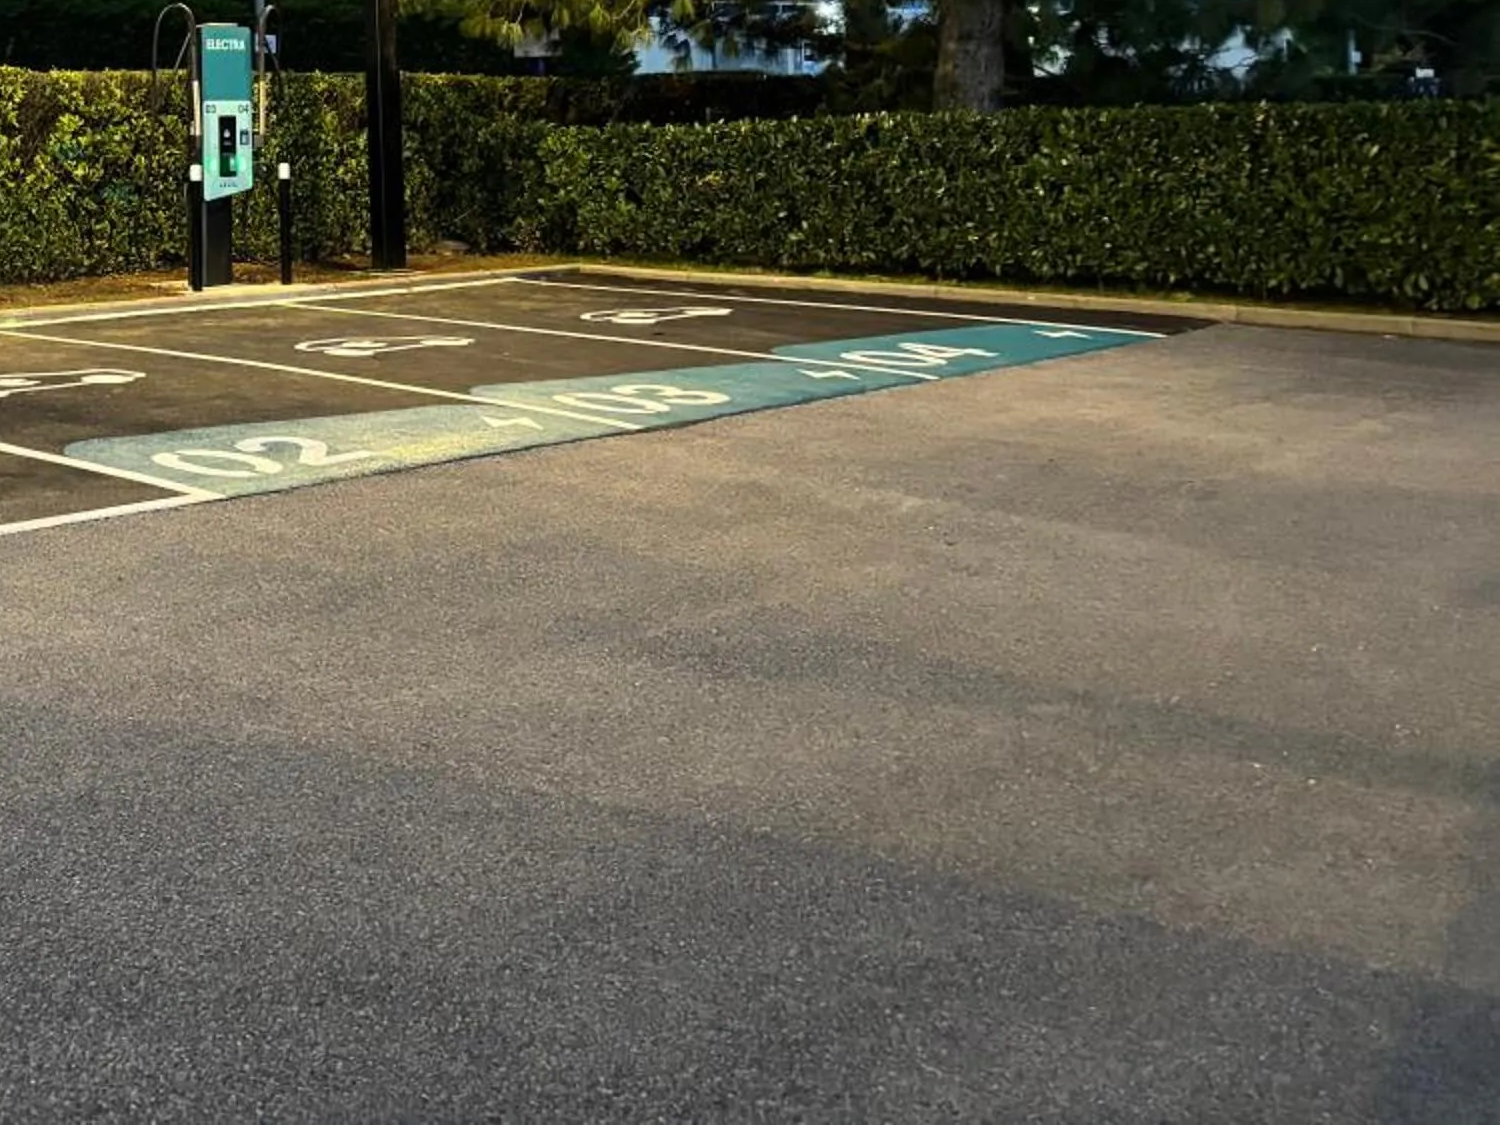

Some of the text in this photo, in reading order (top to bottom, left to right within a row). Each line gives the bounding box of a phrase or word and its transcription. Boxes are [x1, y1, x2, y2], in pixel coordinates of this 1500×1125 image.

[206, 38, 245, 51] ELECTRA
[238, 104, 249, 114] 04
[840, 342, 999, 367] 04
[552, 384, 731, 414] 03
[151, 436, 373, 478] 02
